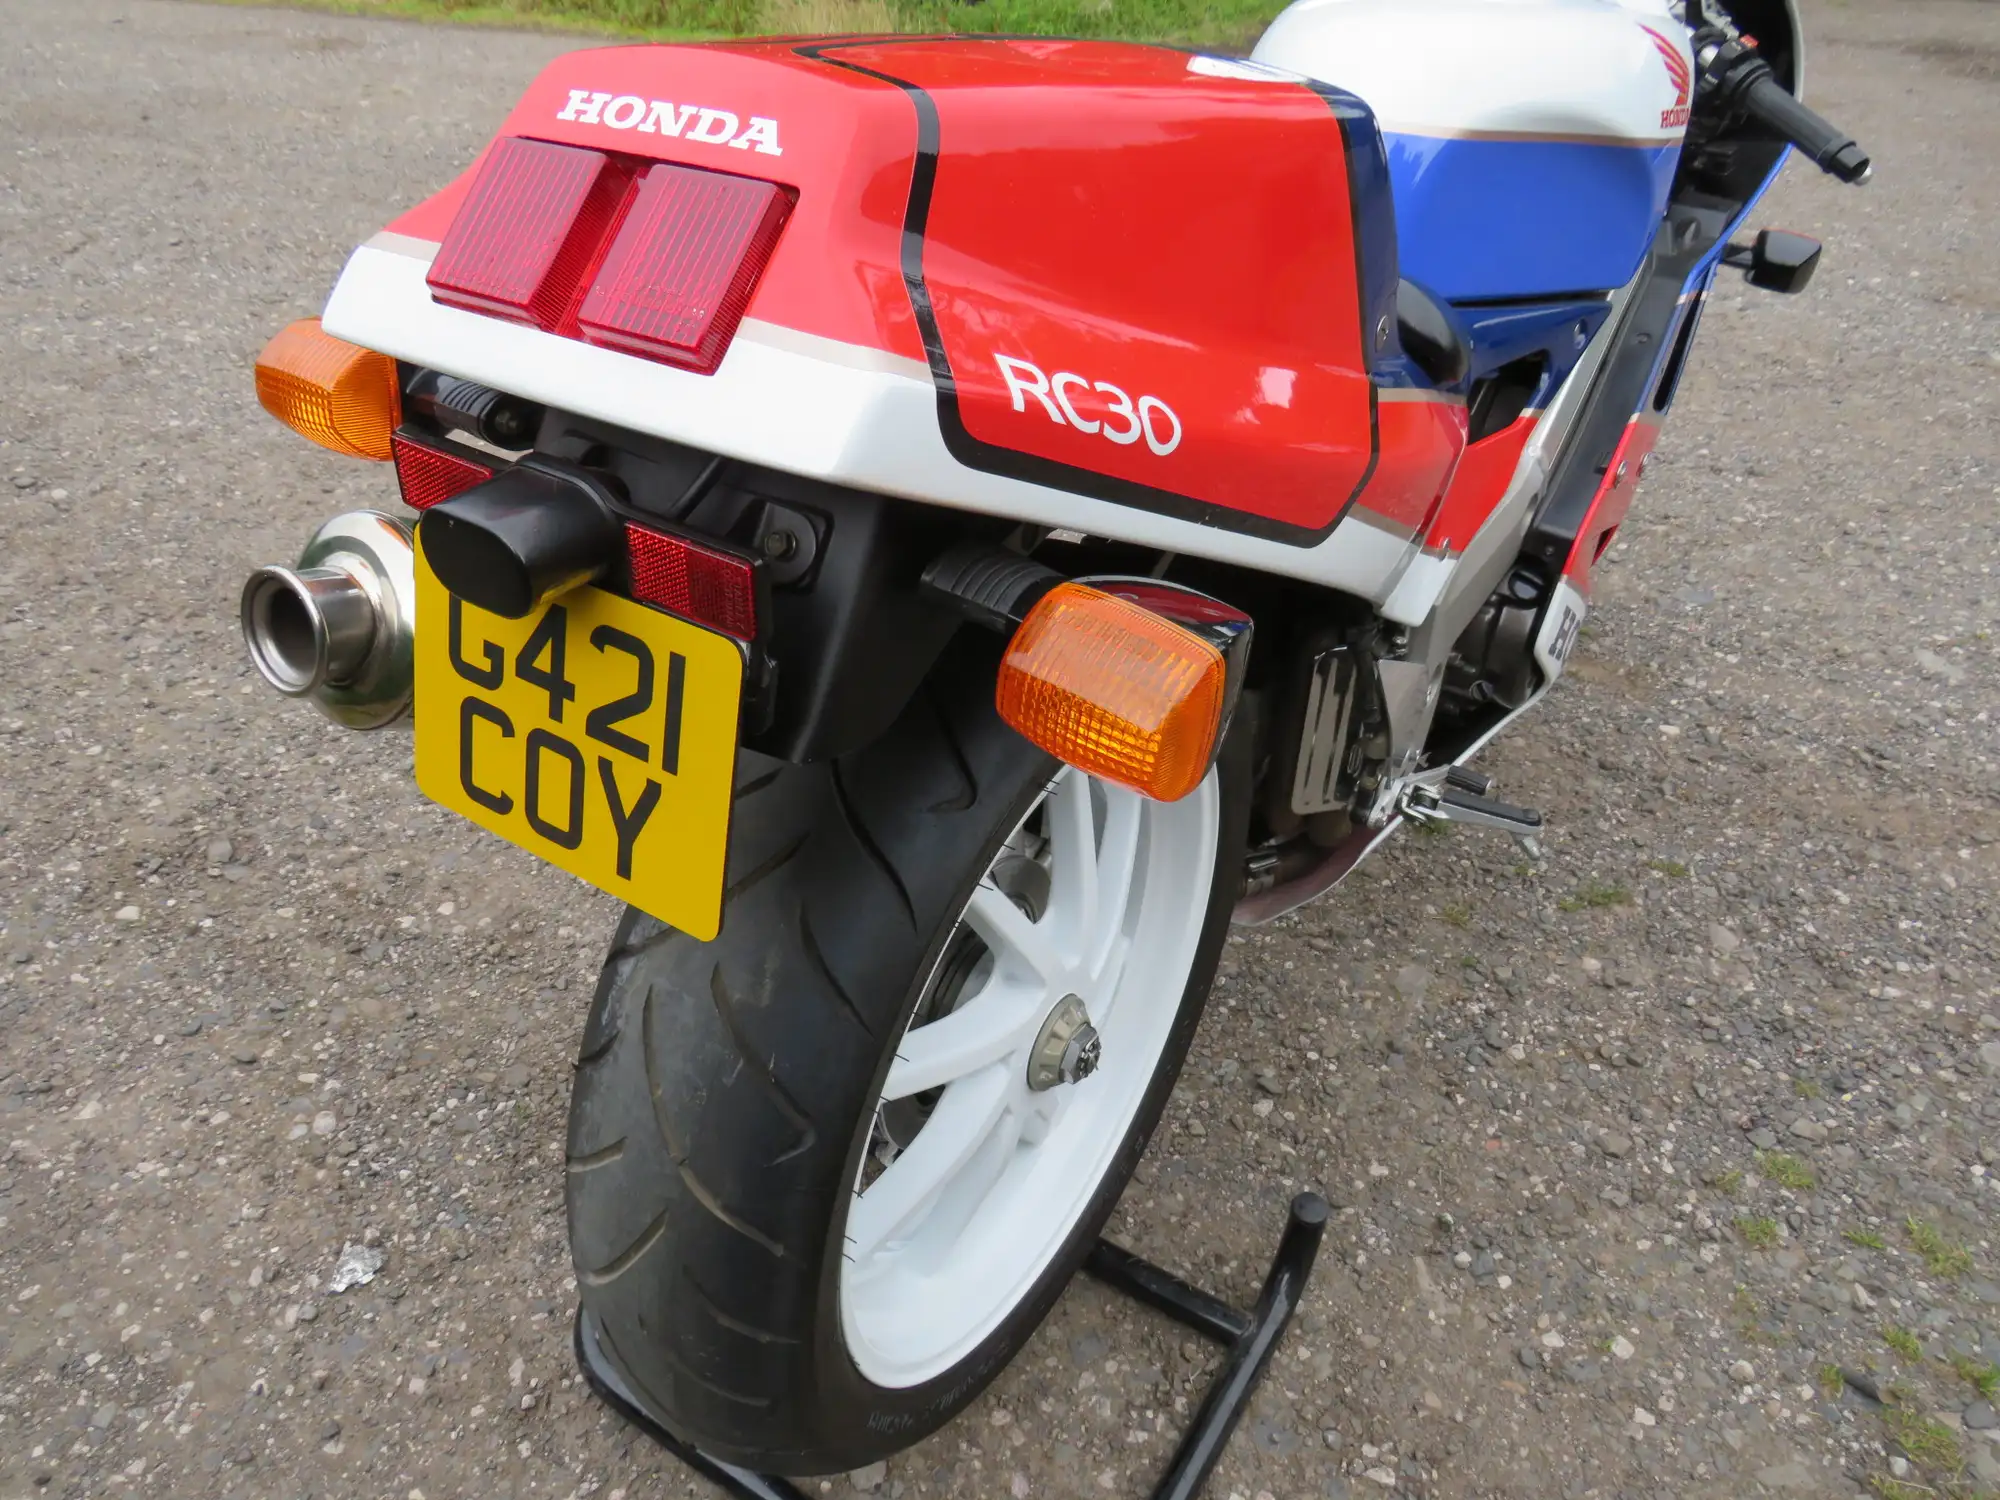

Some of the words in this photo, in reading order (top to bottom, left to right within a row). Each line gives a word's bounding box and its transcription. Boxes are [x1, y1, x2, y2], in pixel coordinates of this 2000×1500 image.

[556, 89, 783, 156] HONDA
[1660, 108, 1690, 128] HOND
[993, 353, 1182, 457] RC30
[448, 592, 687, 776] G421
[460, 696, 662, 881] COY
